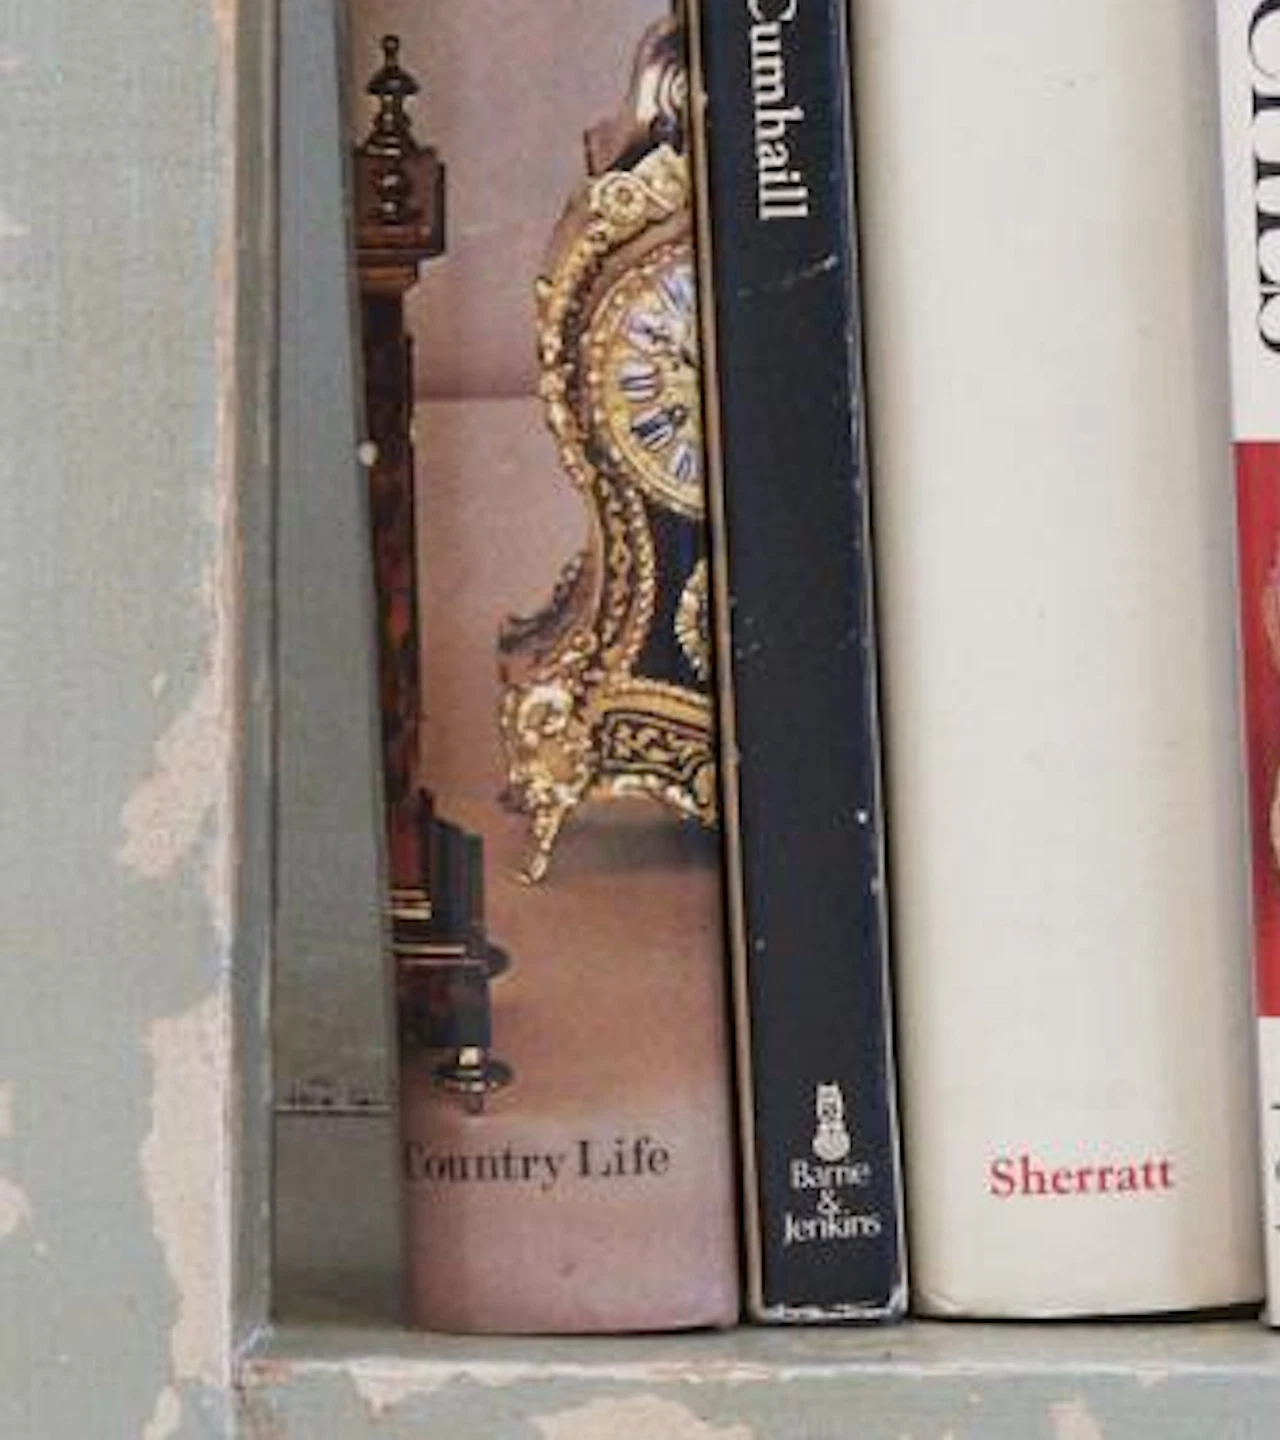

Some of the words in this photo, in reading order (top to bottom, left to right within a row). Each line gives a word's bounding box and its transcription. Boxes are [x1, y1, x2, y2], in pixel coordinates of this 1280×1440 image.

[401, 1140, 566, 1191] Country
[579, 1135, 671, 1178] Life
[989, 1154, 1176, 1197] Sherratt
[816, 1190, 840, 1214] &
[783, 1210, 882, 1245] Jenkins
